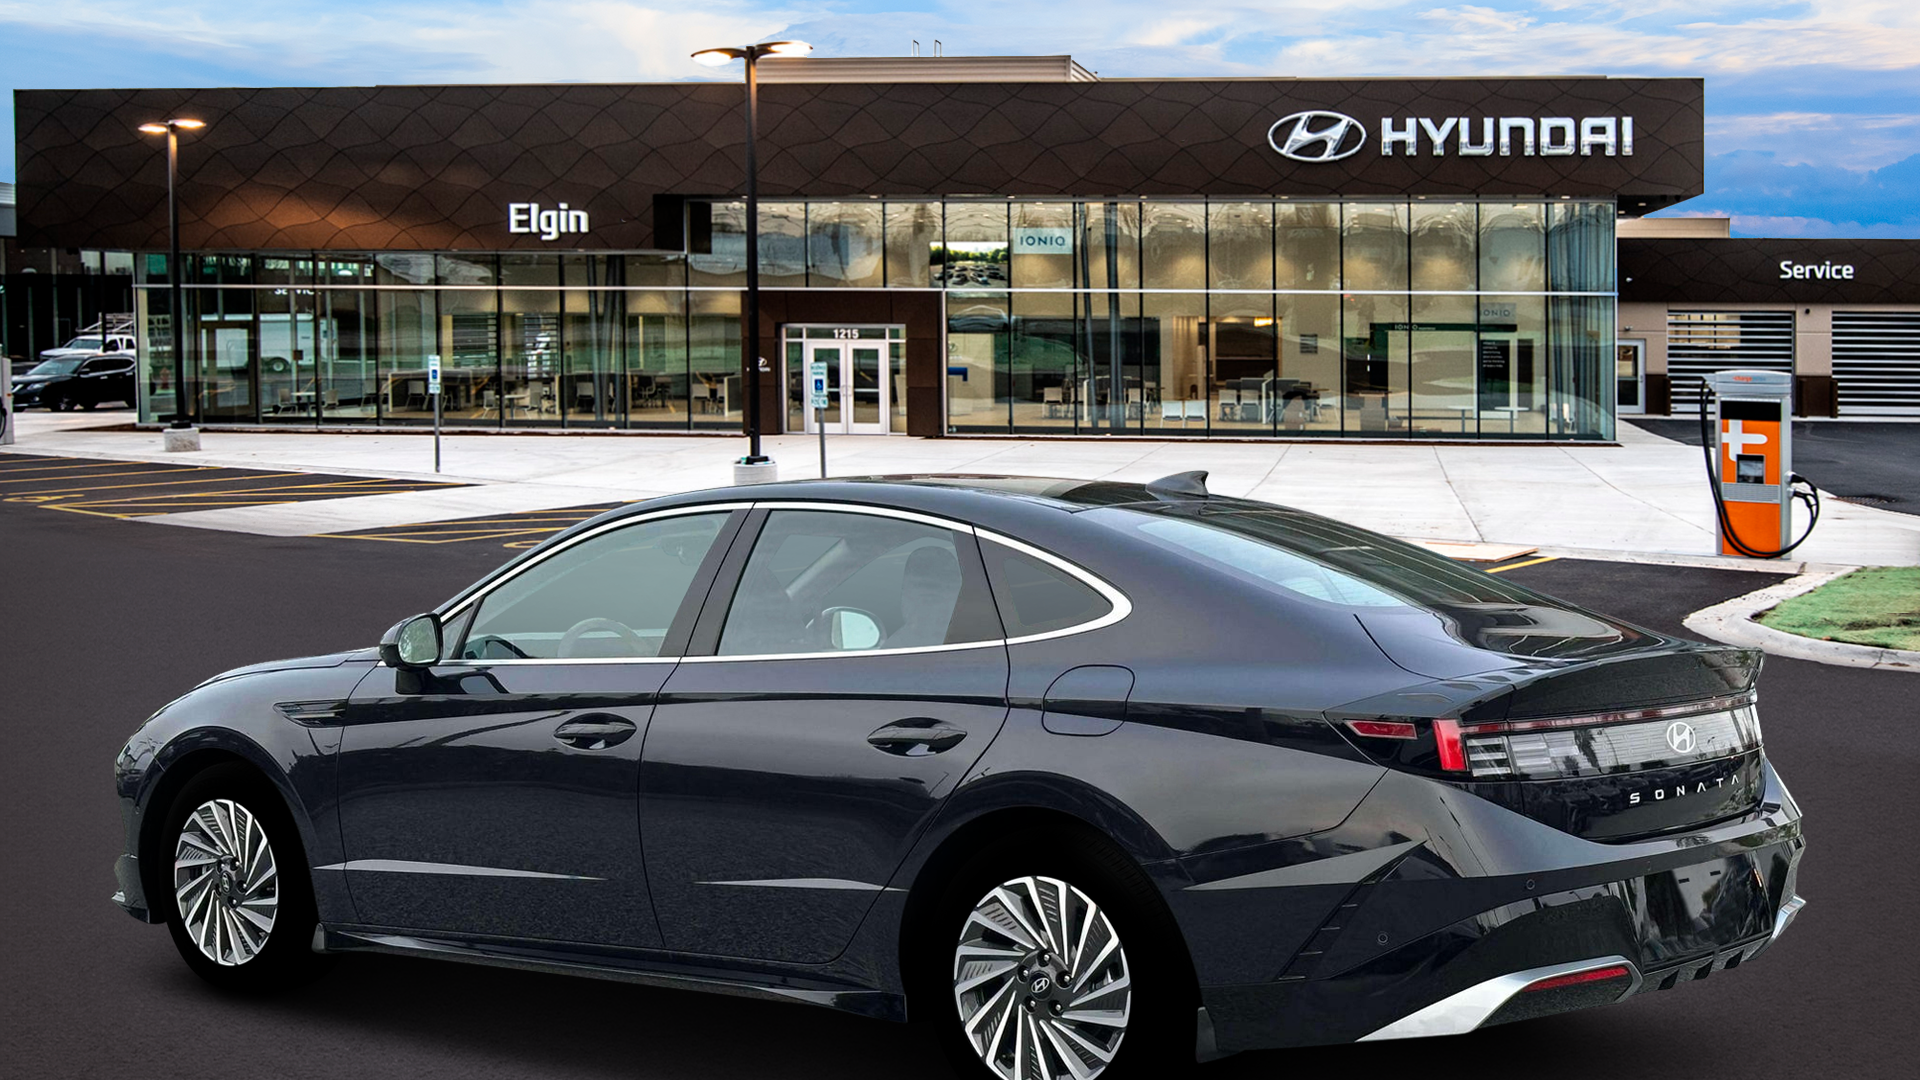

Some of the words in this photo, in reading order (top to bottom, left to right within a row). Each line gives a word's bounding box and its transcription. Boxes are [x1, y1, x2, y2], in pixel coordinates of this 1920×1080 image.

[1381, 117, 1633, 156] HYUNDAI
[508, 203, 589, 240] Elgin
[1020, 236, 1066, 247] IONIQ
[1780, 260, 1854, 279] Service
[833, 328, 859, 339] 1215
[1630, 774, 1740, 804] SONATA
